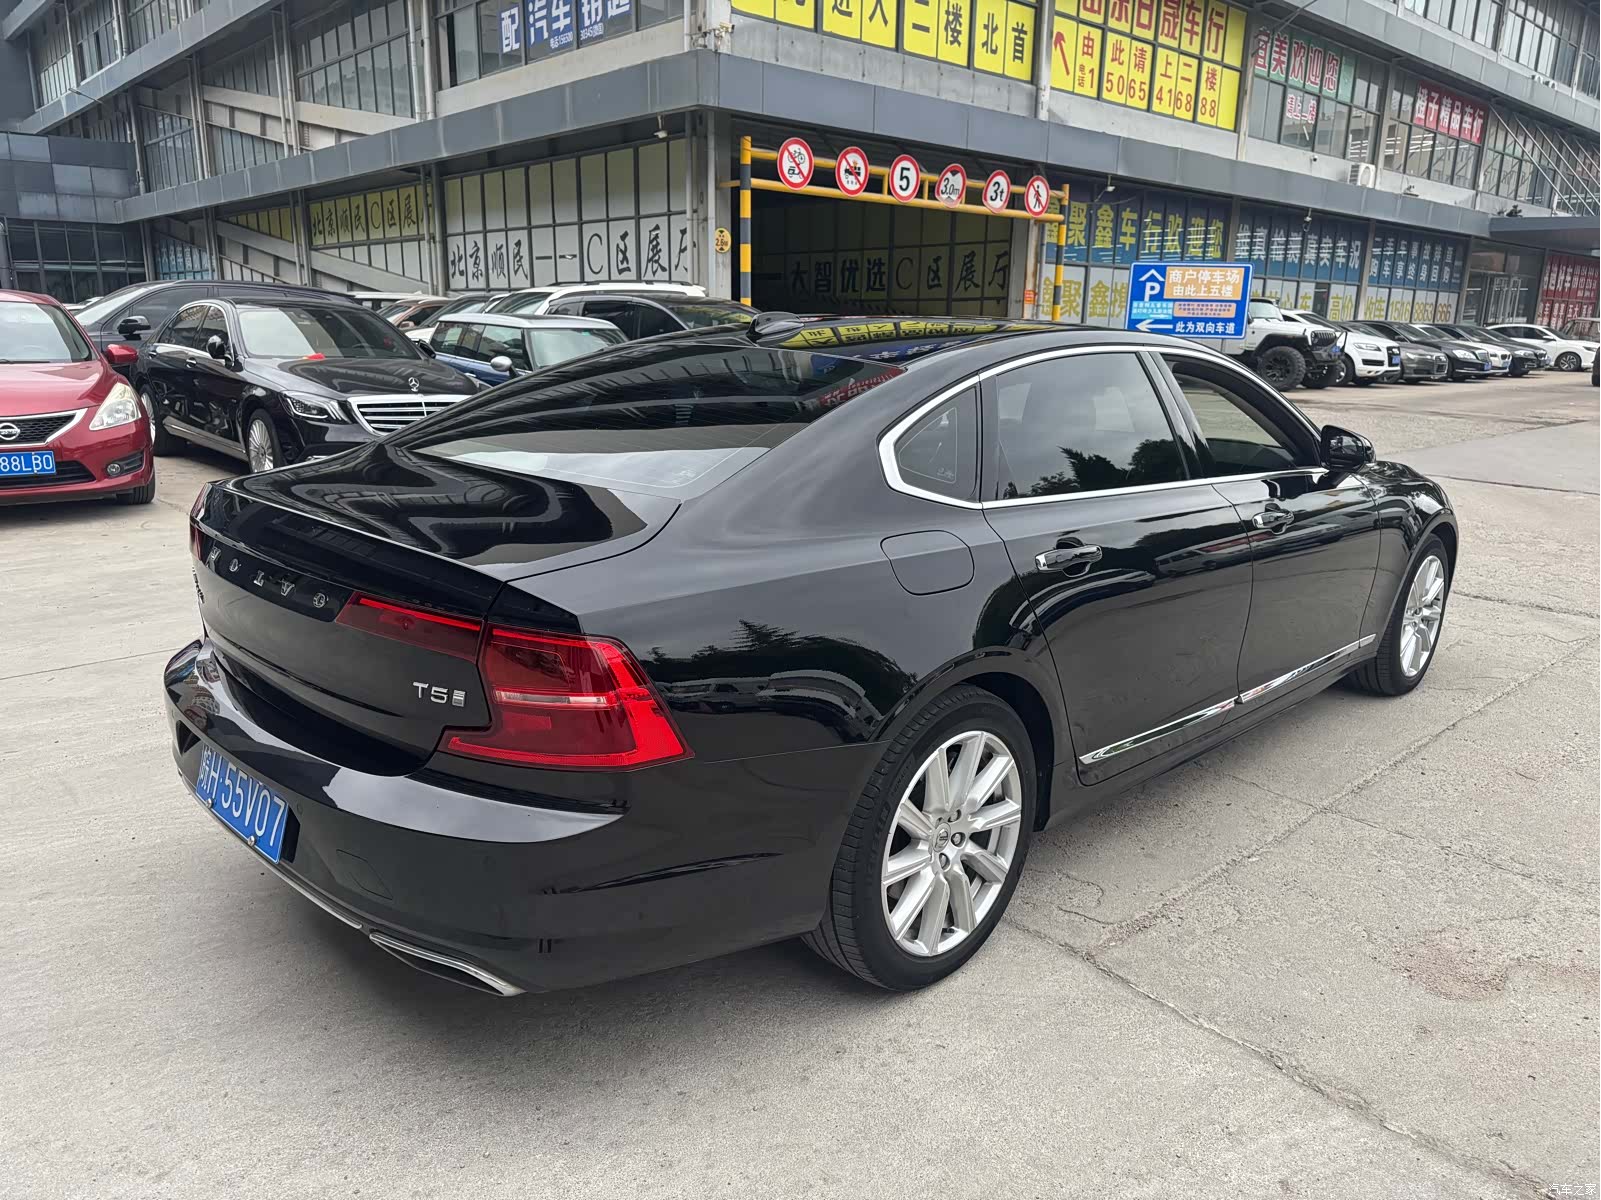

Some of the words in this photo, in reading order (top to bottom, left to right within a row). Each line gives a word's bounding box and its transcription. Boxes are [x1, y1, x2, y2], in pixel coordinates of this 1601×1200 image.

[793, 0, 1028, 63] 入二楼北首
[1082, 31, 1218, 92] 由此请上二楼
[1415, 86, 1484, 139] 橙子精品车行
[899, 170, 911, 192] 5
[941, 177, 960, 196] 3.0m
[990, 181, 1005, 202] 3t
[1169, 269, 1240, 285] 商户停车场
[1144, 281, 1161, 302] P
[1173, 284, 1234, 298] 由此上五楼
[1175, 321, 1235, 335] 此为双向车道
[205, 546, 329, 608] VOLVO
[412, 681, 449, 704] T5
